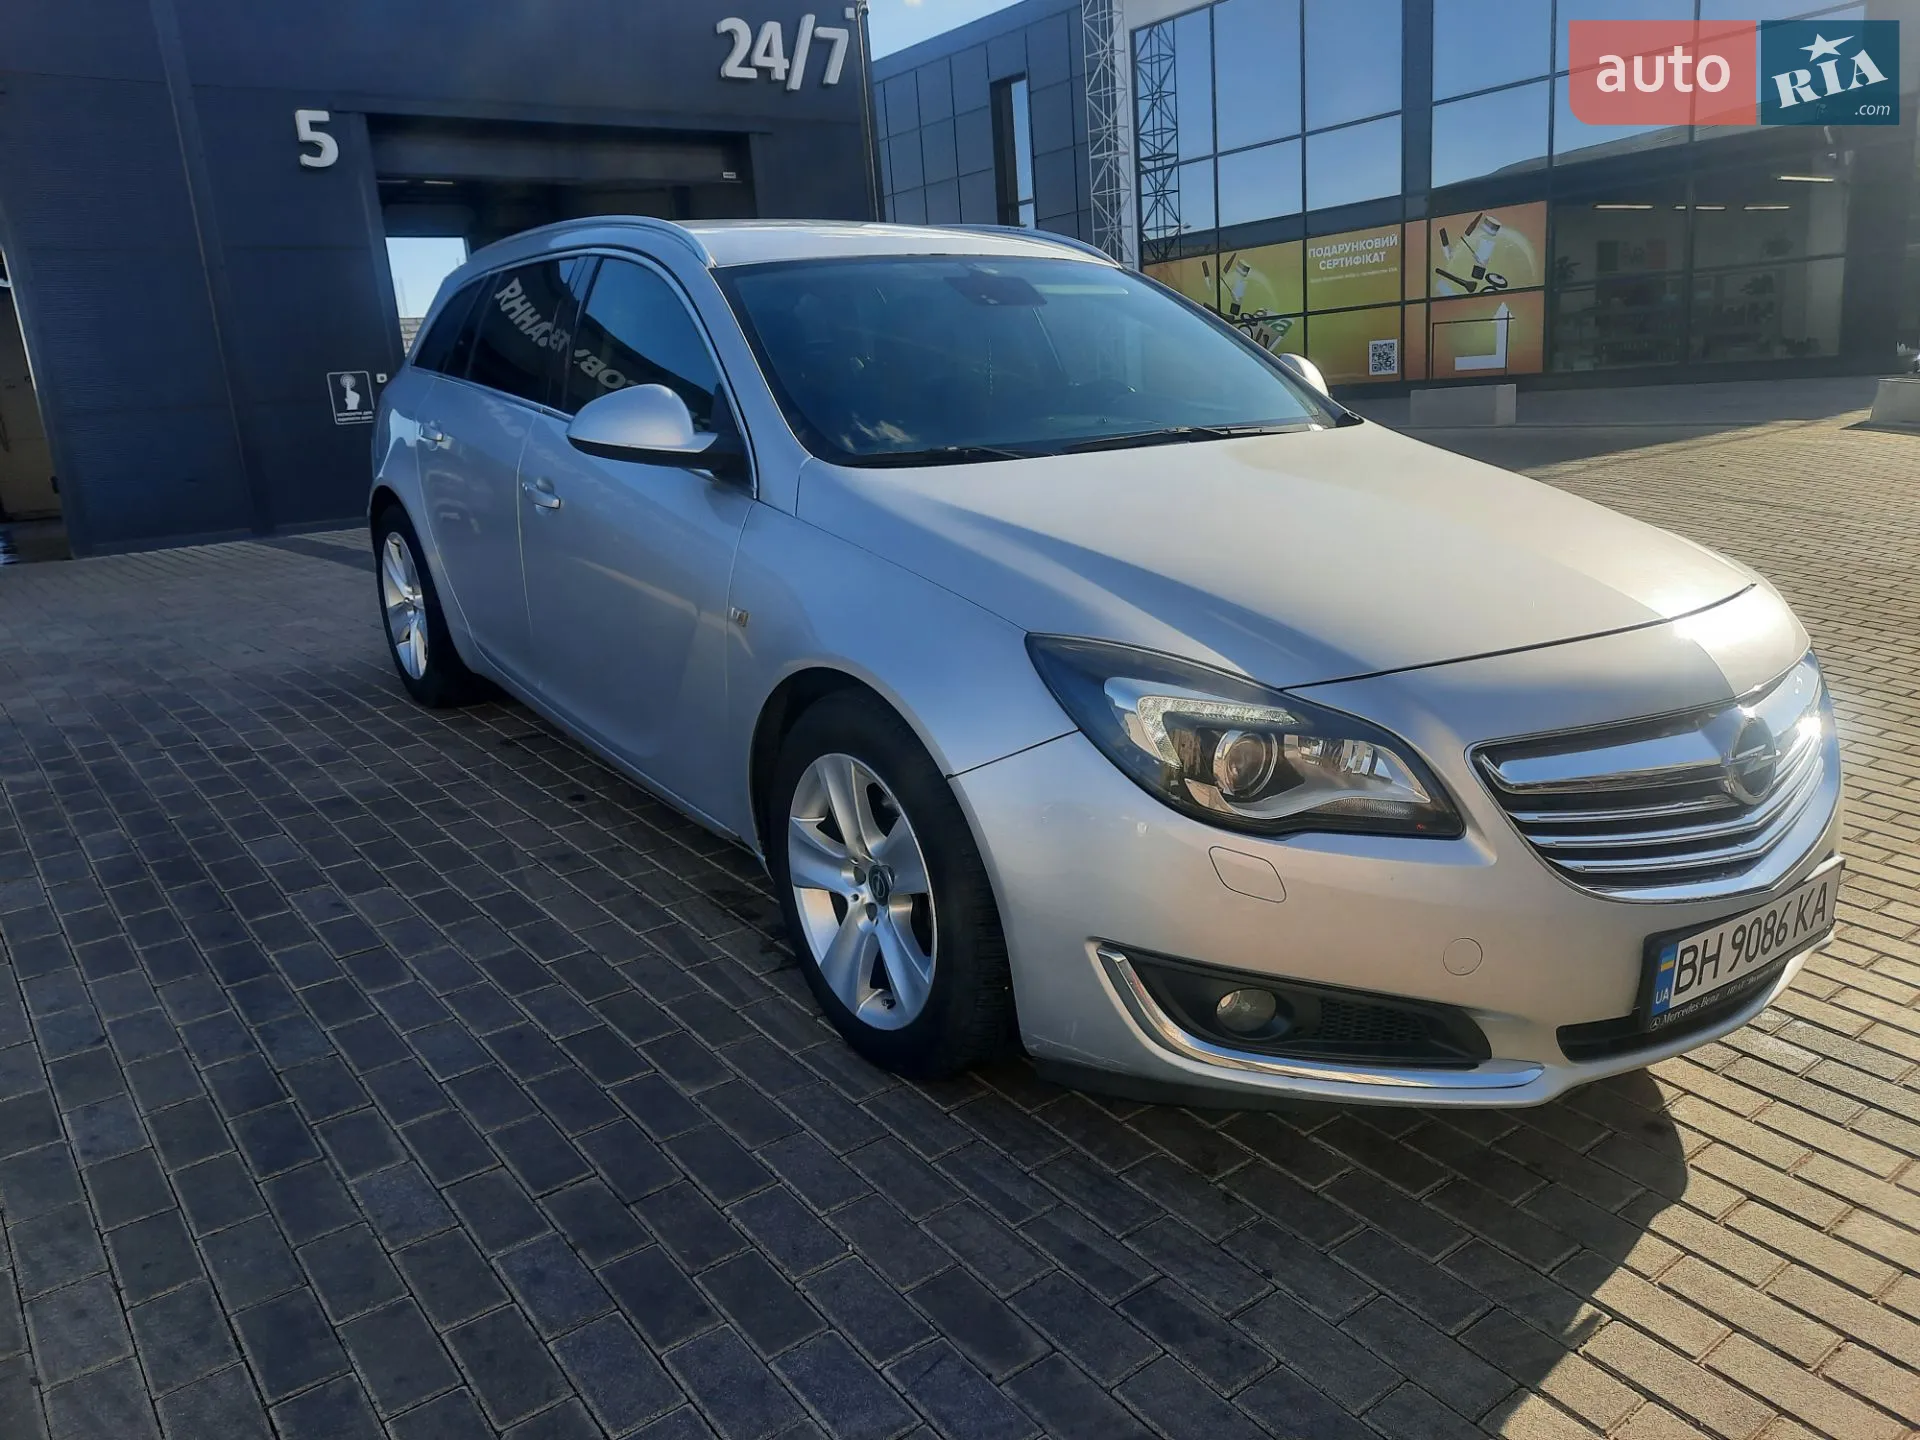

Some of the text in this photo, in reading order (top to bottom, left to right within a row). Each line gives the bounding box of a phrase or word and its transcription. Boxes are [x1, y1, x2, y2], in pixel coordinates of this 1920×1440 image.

[716, 14, 849, 90] 24/7
[295, 109, 339, 167] 5
[1308, 234, 1398, 258] ПОДАРУНКОВИЙ
[1319, 251, 1386, 271] СЕРТИФІКАТ
[1674, 932, 1724, 997] BH
[1727, 900, 1792, 974] 9086
[1792, 881, 1828, 938] KA
[1655, 988, 1669, 1005] UA
